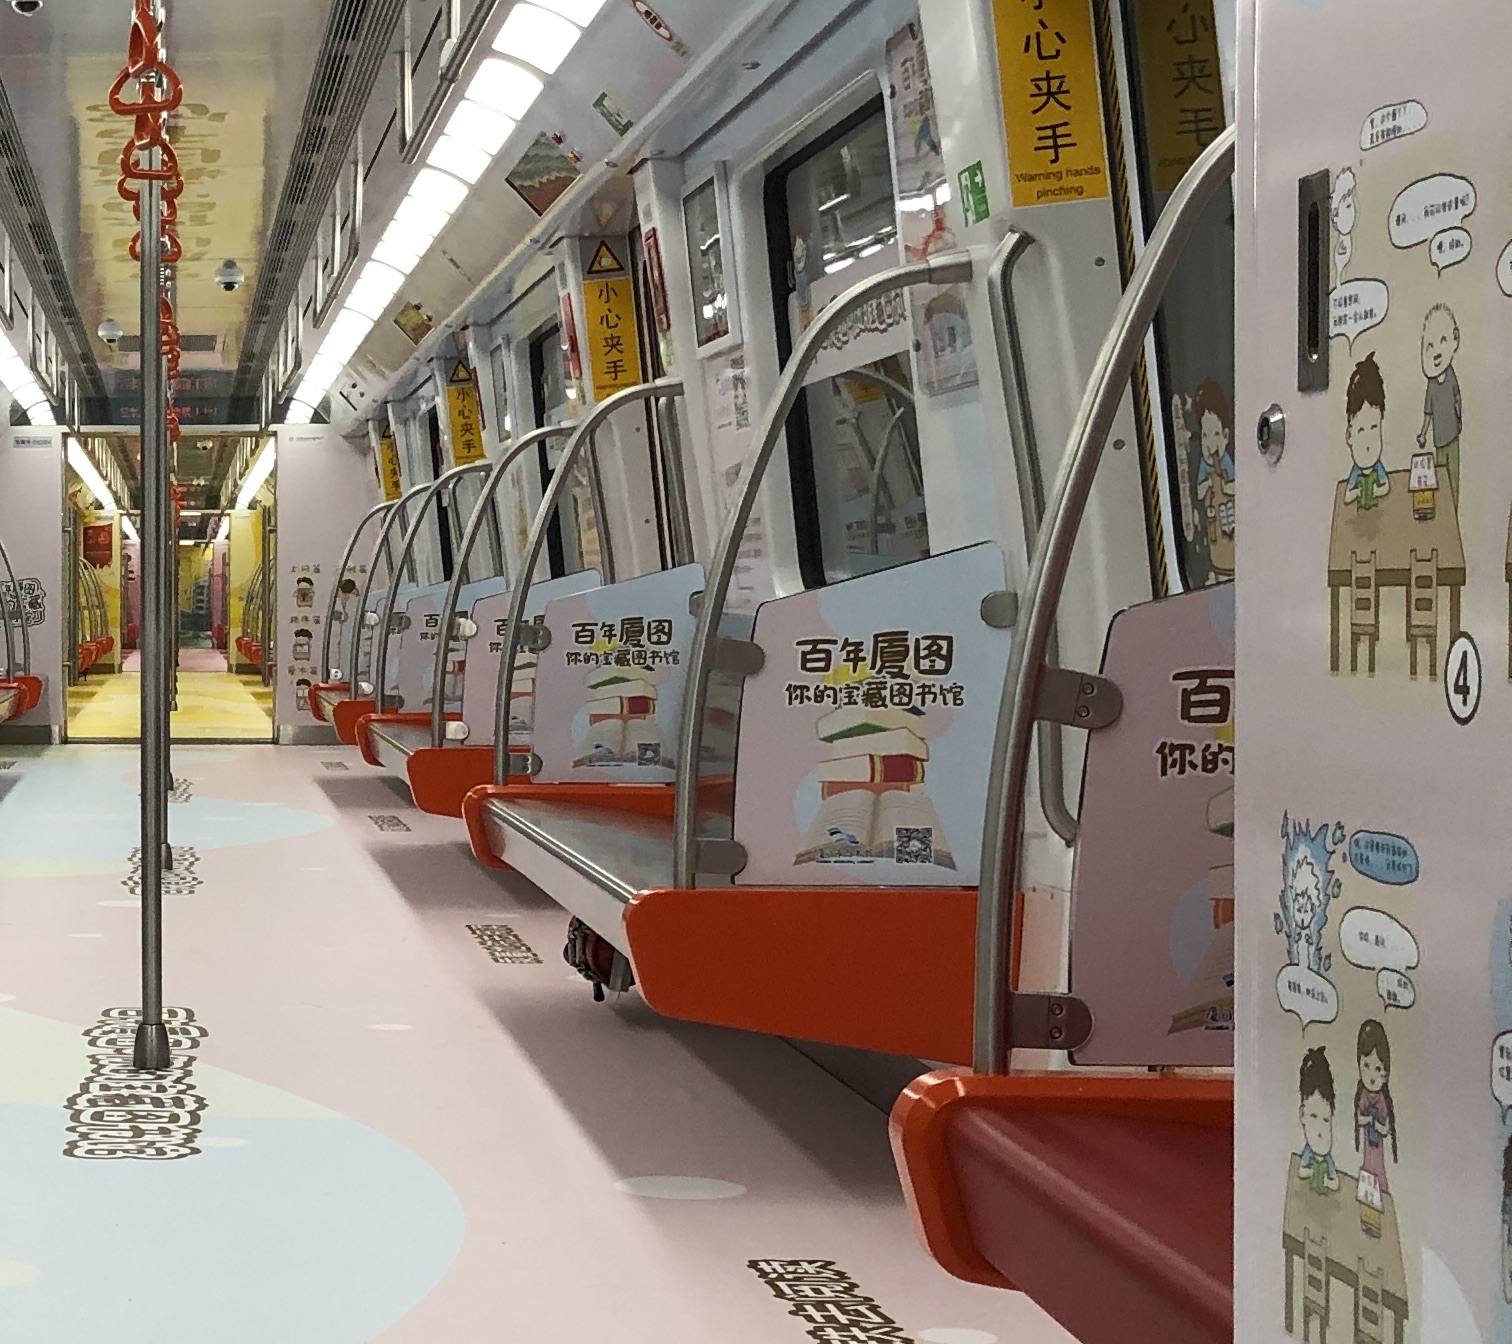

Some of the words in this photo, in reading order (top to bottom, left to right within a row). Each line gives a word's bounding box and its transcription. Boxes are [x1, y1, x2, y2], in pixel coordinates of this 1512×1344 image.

[1015, 168, 1062, 185] Warning
[1064, 165, 1102, 180] hands
[1035, 183, 1085, 200] pinching
[597, 282, 627, 381] 小心夹手
[571, 617, 673, 649] 百年厦图
[565, 649, 681, 668] 你的宝藏图书馆
[794, 631, 955, 679] 百年厦图
[785, 681, 965, 709] 你的宝藏图书馆
